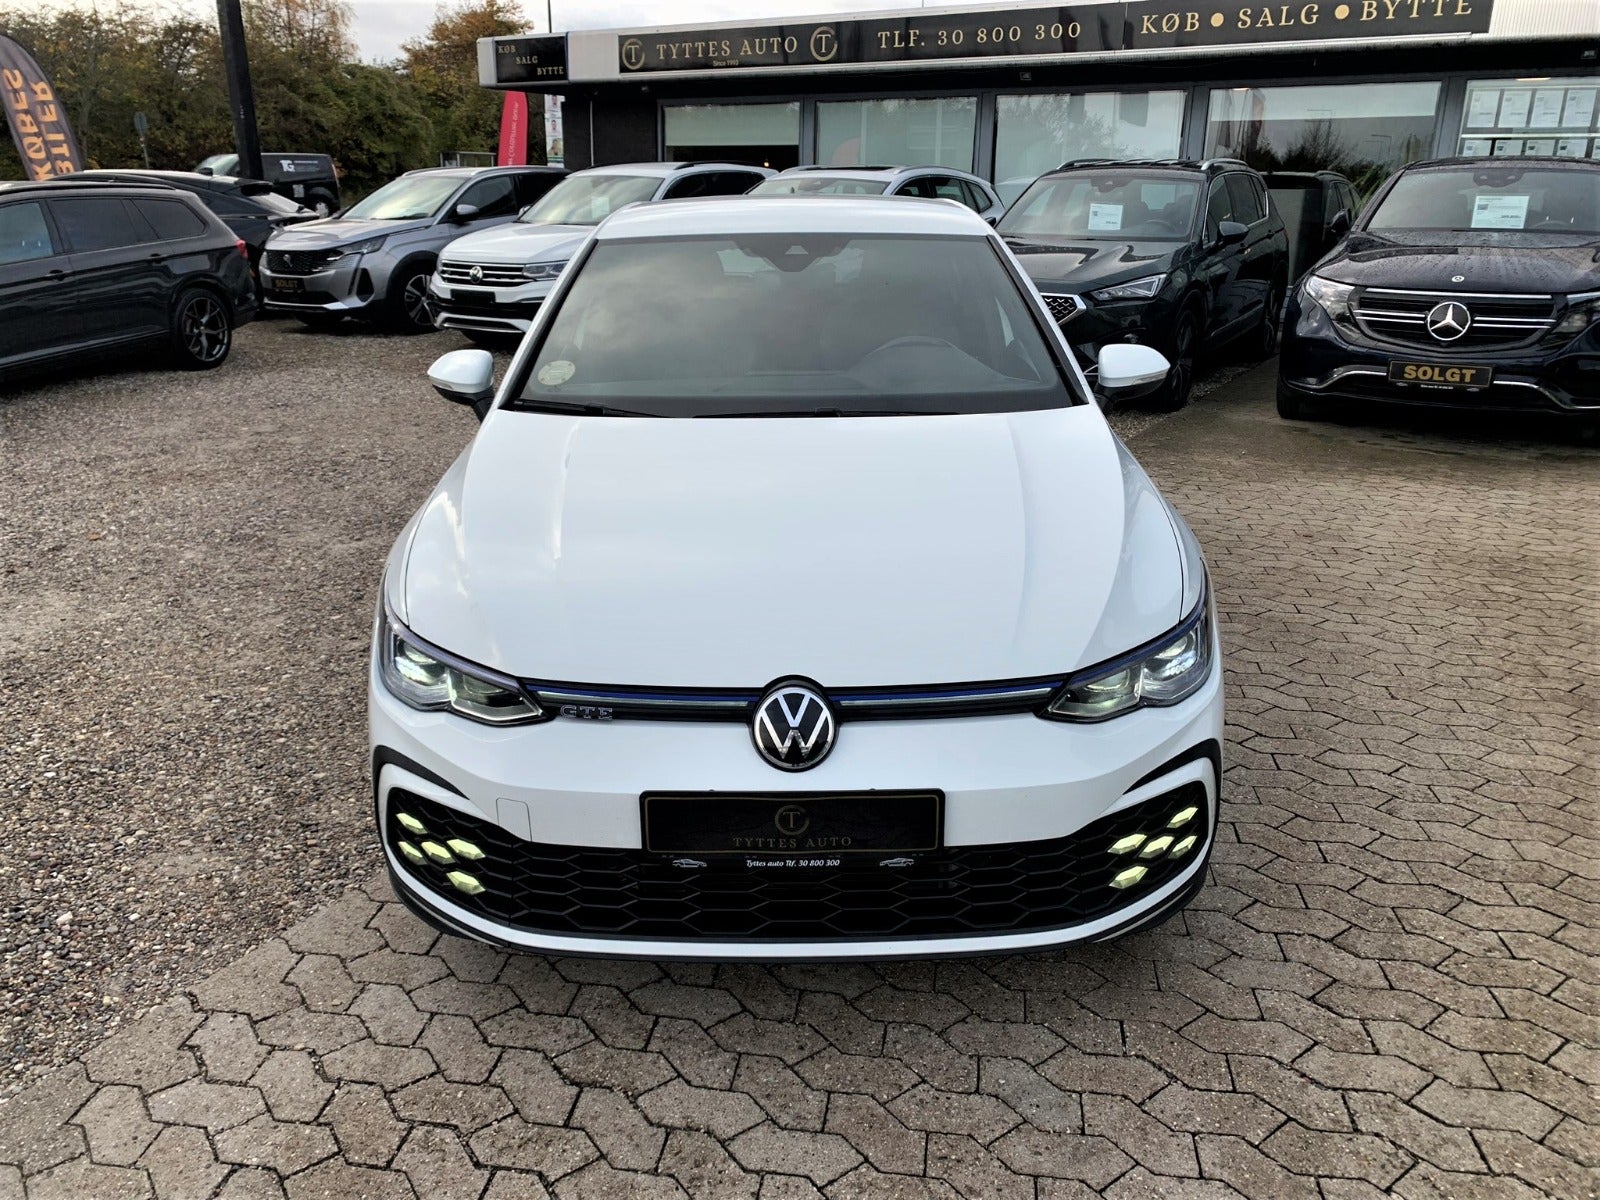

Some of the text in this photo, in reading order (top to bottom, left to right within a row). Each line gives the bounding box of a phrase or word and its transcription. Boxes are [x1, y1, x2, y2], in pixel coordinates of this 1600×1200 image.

[1141, 0, 1472, 34] KØB SALG BYTTE
[877, 22, 1081, 48] TLF. 30 800 300
[657, 36, 797, 59] TYTTES AUTO
[515, 55, 538, 65] SALG
[537, 66, 564, 76] BYTTE
[1403, 365, 1476, 383] SOLGT
[560, 704, 613, 720] GTE
[733, 836, 852, 849] TYTTES AUTO
[746, 859, 766, 868] Tyttes
[798, 859, 809, 867] 30
[809, 859, 824, 867] 800
[825, 859, 840, 867] 300
